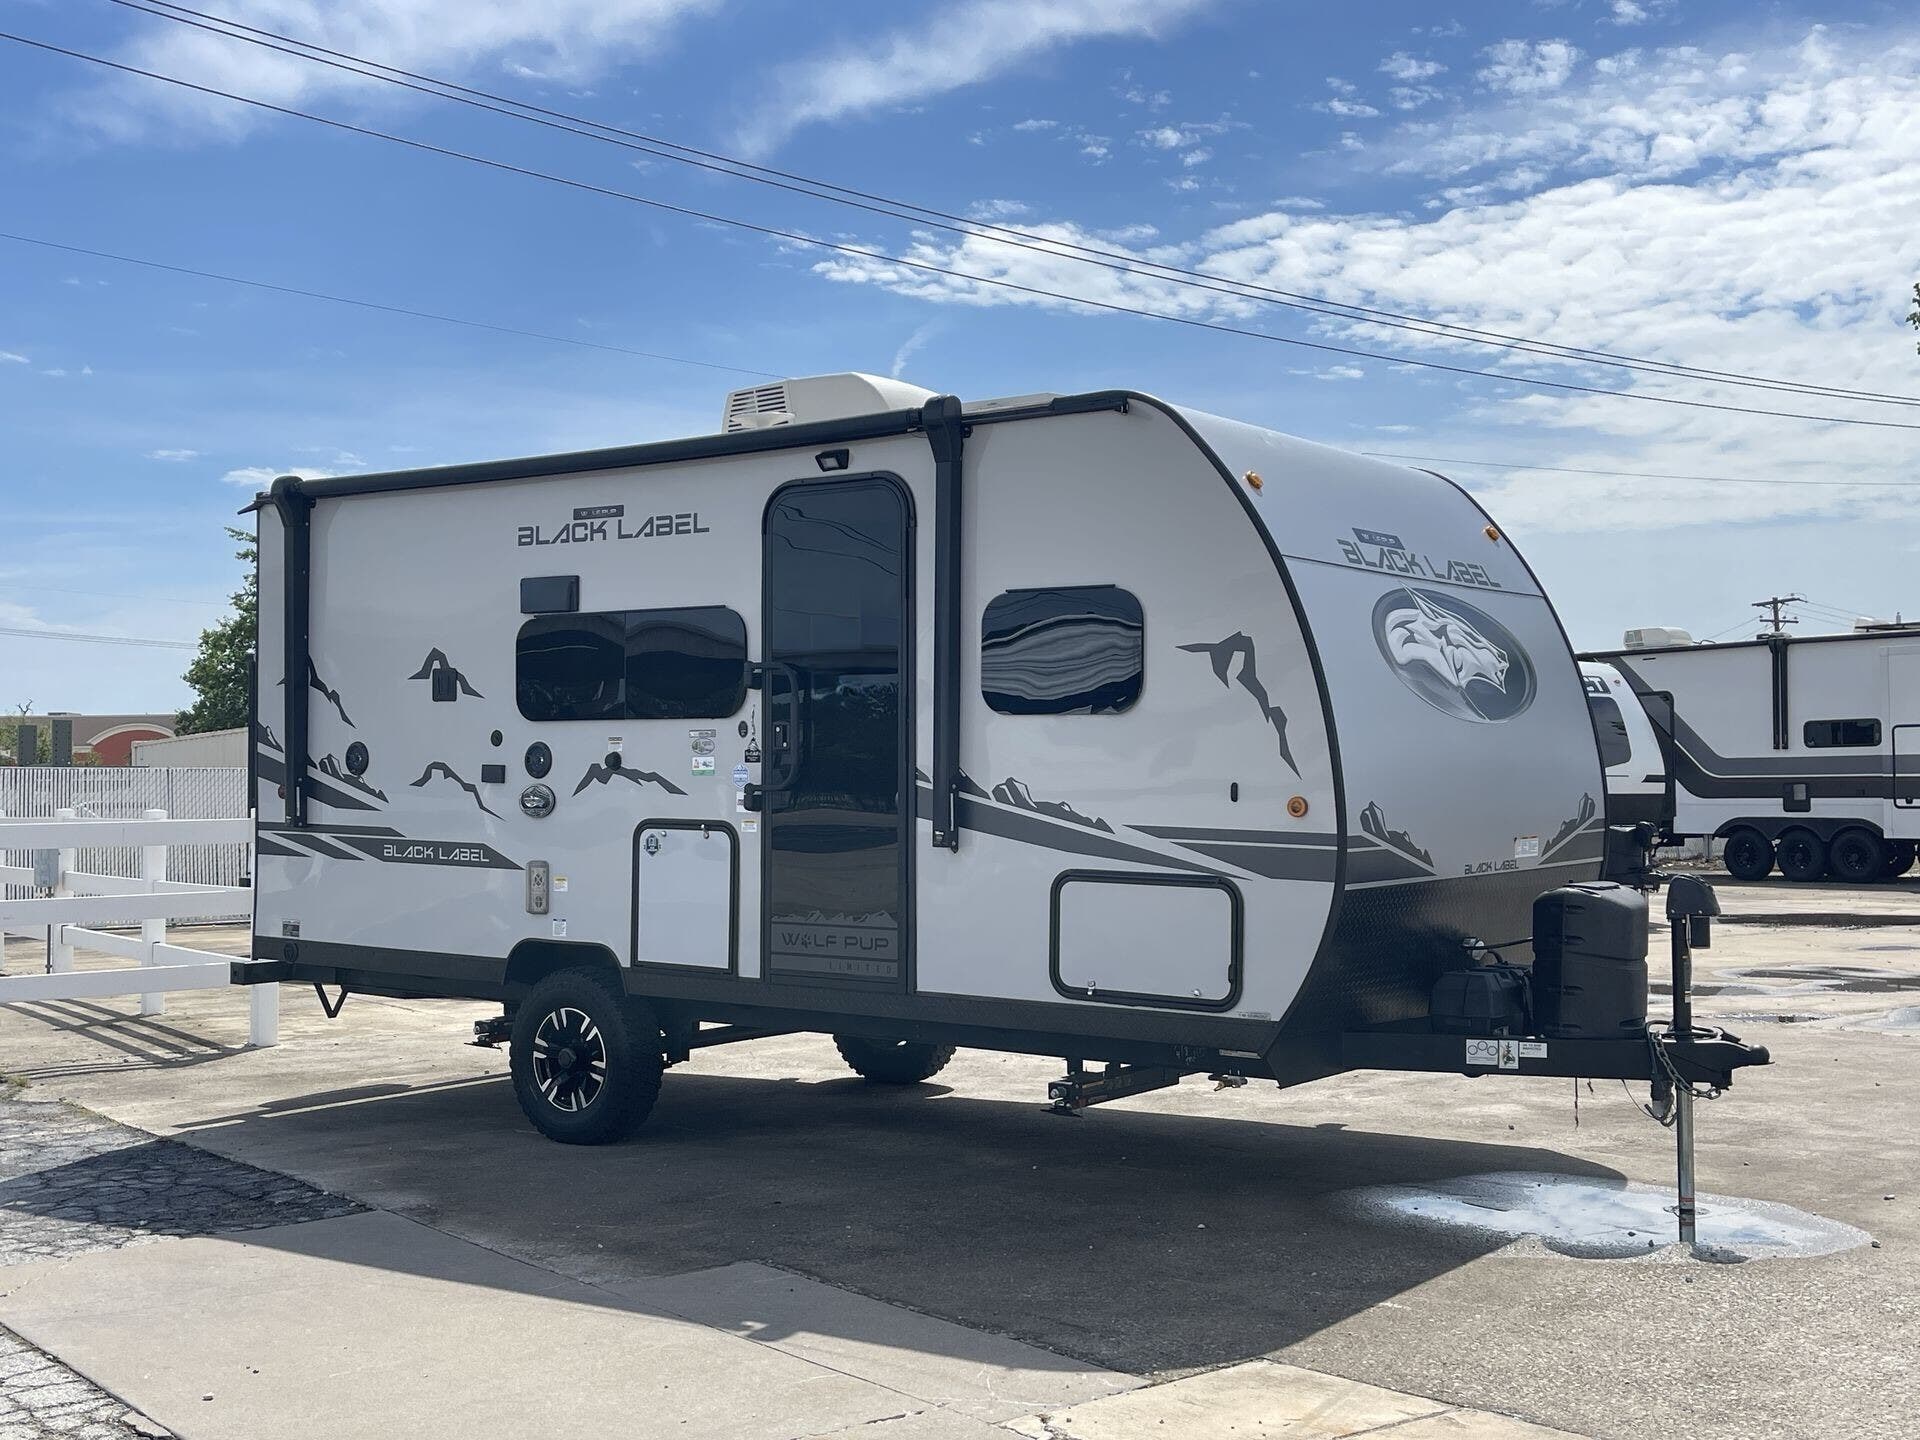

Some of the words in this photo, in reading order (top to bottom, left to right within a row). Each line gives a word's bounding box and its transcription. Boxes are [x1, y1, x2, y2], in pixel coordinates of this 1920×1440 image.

[518, 520, 608, 547] BLACK
[617, 512, 710, 540] LABEL
[1336, 538, 1426, 576] BLACK
[1424, 555, 1502, 588] LABEL
[383, 844, 434, 859] BLACK
[439, 847, 490, 862] LABEL
[1464, 861, 1493, 875] BLACK
[1494, 860, 1519, 872] LABEL
[844, 936, 889, 951] PUP
